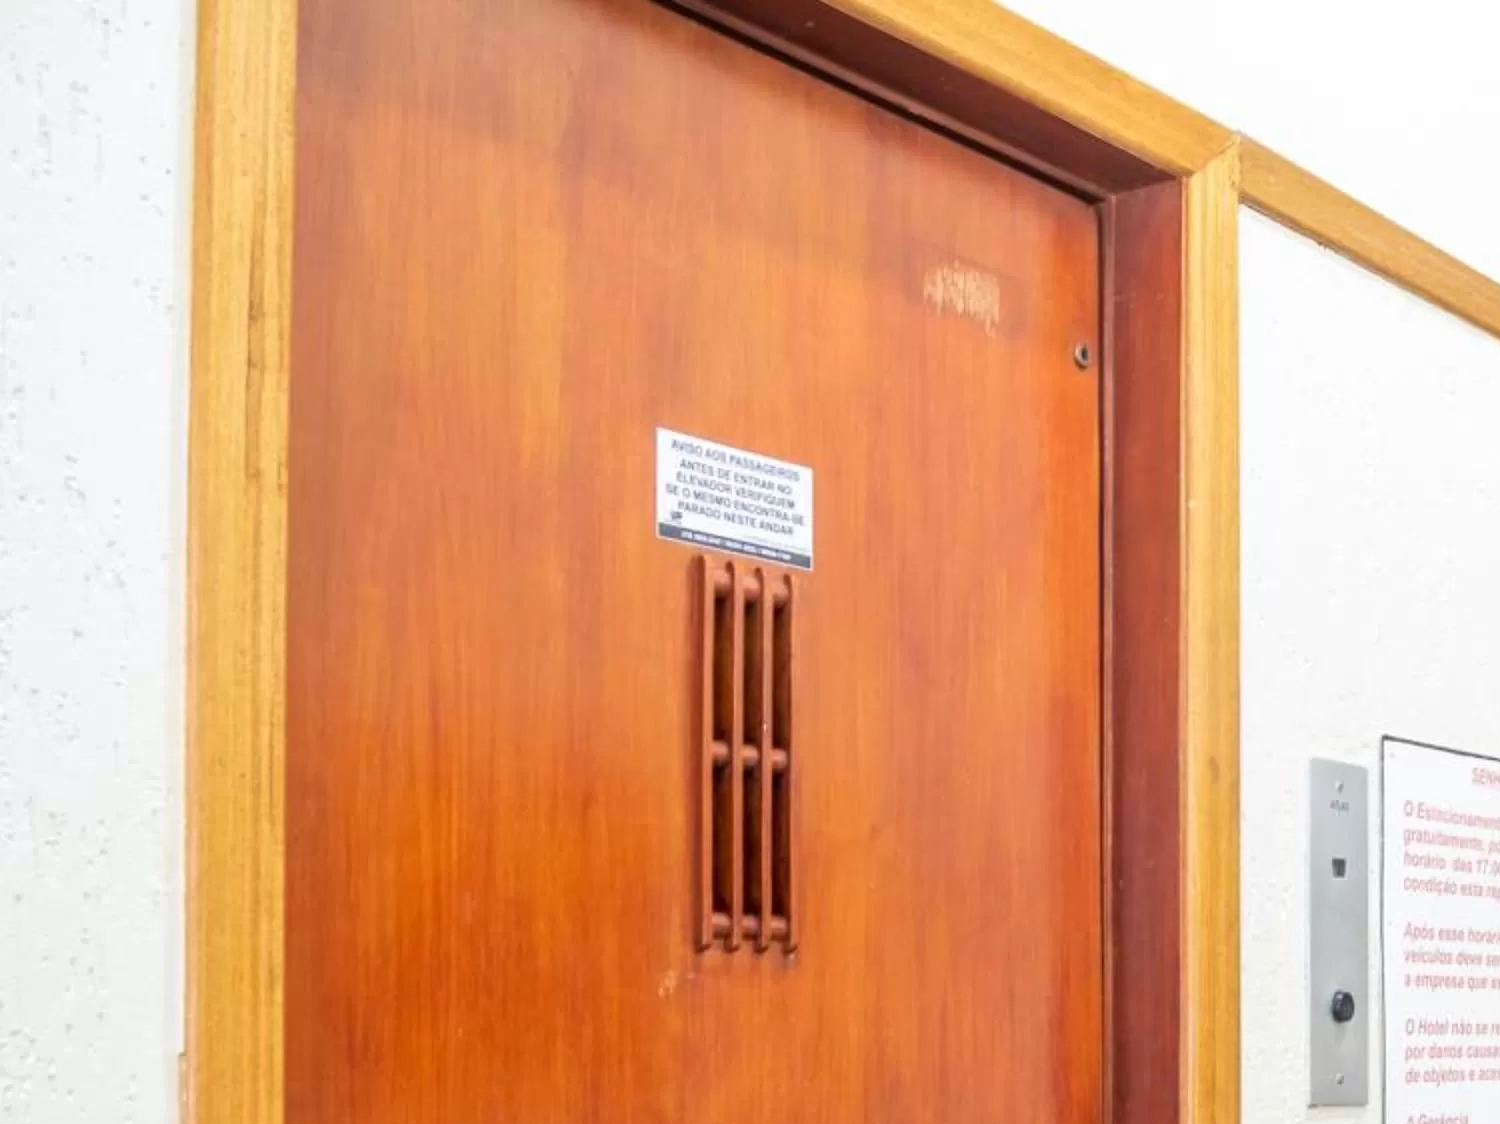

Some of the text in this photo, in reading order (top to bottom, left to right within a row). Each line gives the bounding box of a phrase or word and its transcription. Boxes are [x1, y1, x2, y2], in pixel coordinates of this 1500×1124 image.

[672, 439, 702, 457] AVISO
[705, 448, 726, 463] AOS
[680, 458, 792, 495] ANTES DE ENTRAR NO
[666, 483, 679, 495] SE
[682, 488, 690, 498] O
[694, 490, 731, 508] MESMO
[676, 471, 795, 508] ELEVADOR VERIFIQUEM
[678, 501, 720, 519] PARADO
[724, 512, 756, 528] NESTE
[759, 521, 793, 535] ANDAR
[1403, 800, 1414, 817] O
[1403, 921, 1435, 941] Após
[1438, 927, 1465, 941] esse
[1415, 974, 1465, 990] empresa
[1467, 975, 1487, 992] que
[1405, 1018, 1415, 1035] O
[1418, 1019, 1448, 1035] Hotel
[1451, 1019, 1472, 1035] não
[1476, 1022, 1487, 1035] se
[1405, 1045, 1425, 1063] por
[1405, 1068, 1420, 1085] de
[1423, 1066, 1465, 1087] objetos
[1468, 1069, 1475, 1081] e
